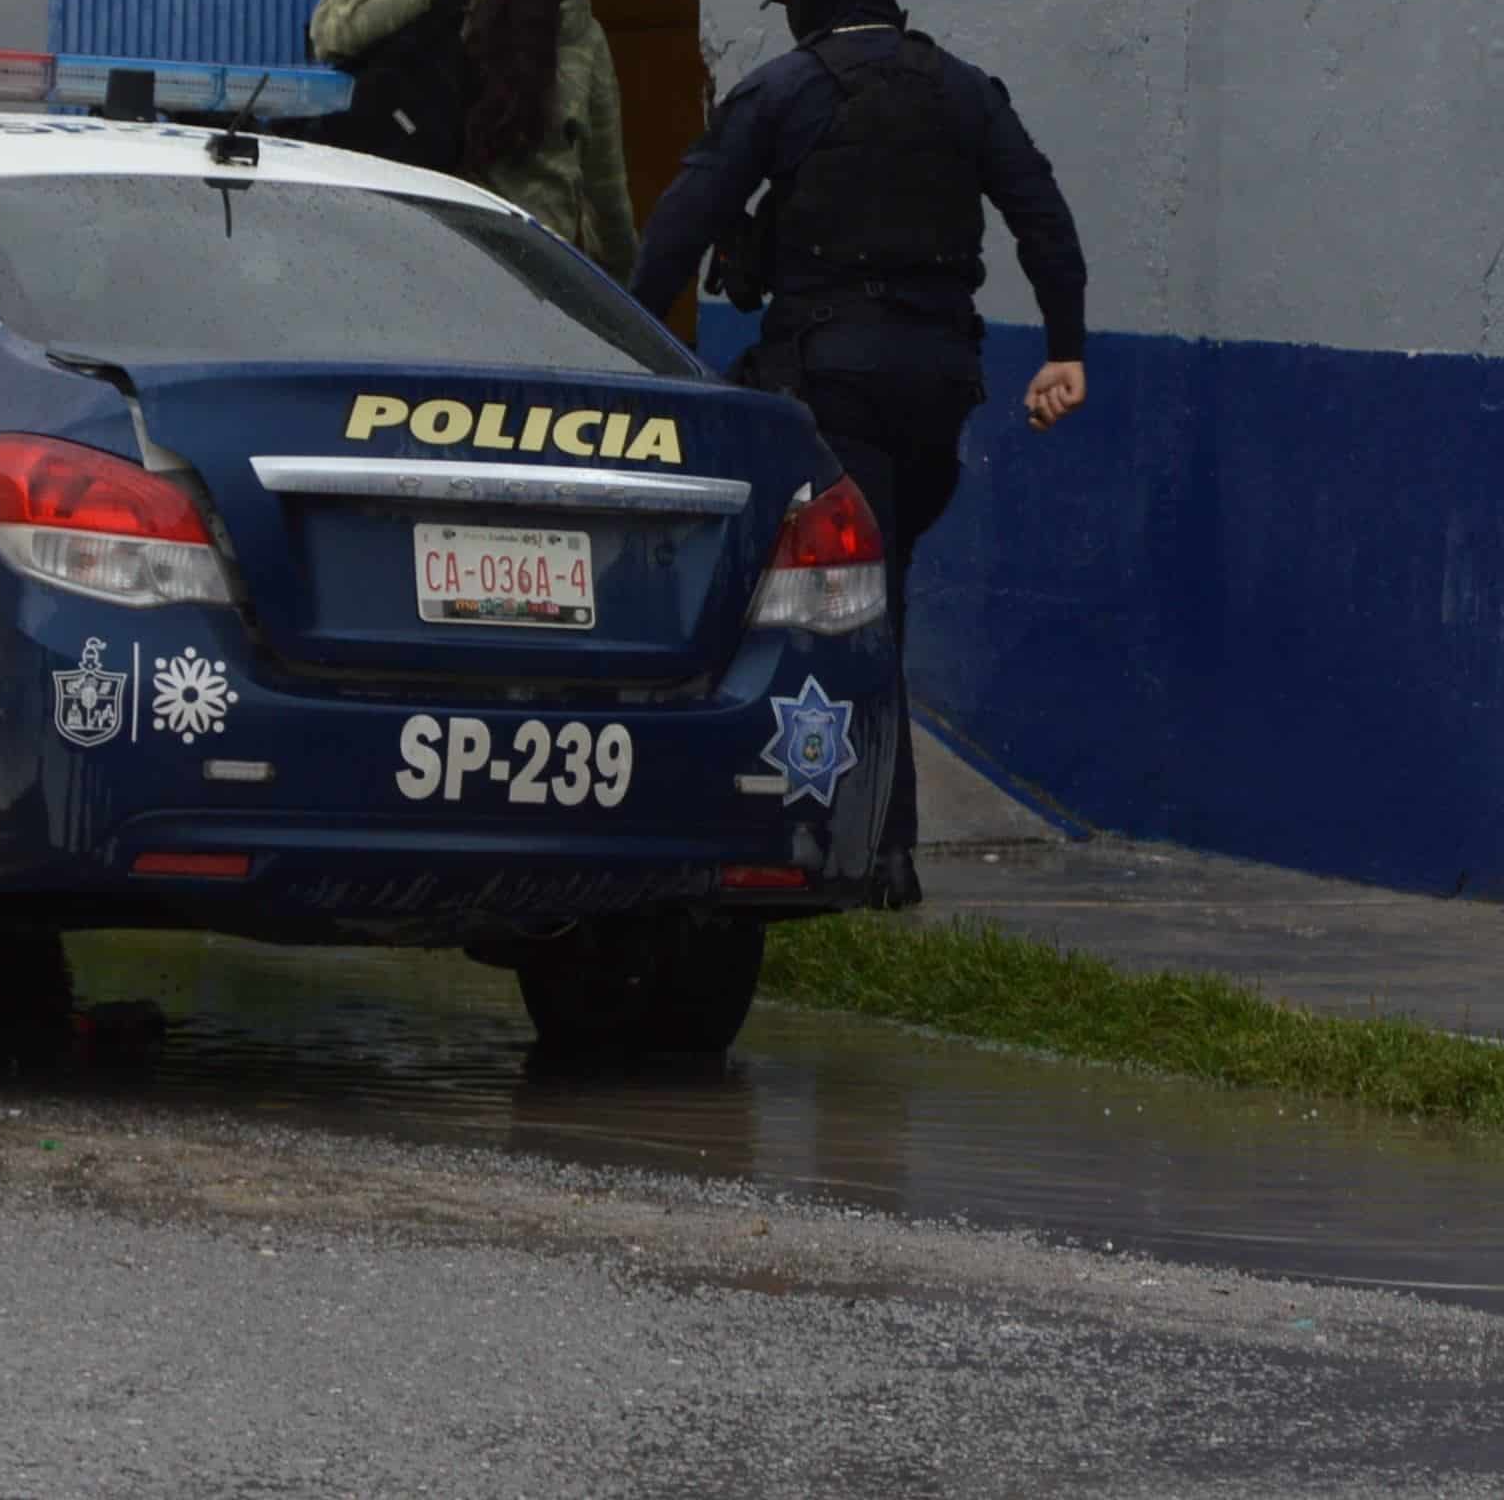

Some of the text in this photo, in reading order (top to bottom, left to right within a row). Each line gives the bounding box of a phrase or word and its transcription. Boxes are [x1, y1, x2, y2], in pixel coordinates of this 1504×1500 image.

[345, 394, 683, 465] POLICIA
[425, 550, 587, 598] CA-036A-4
[396, 714, 634, 808] SP-239
